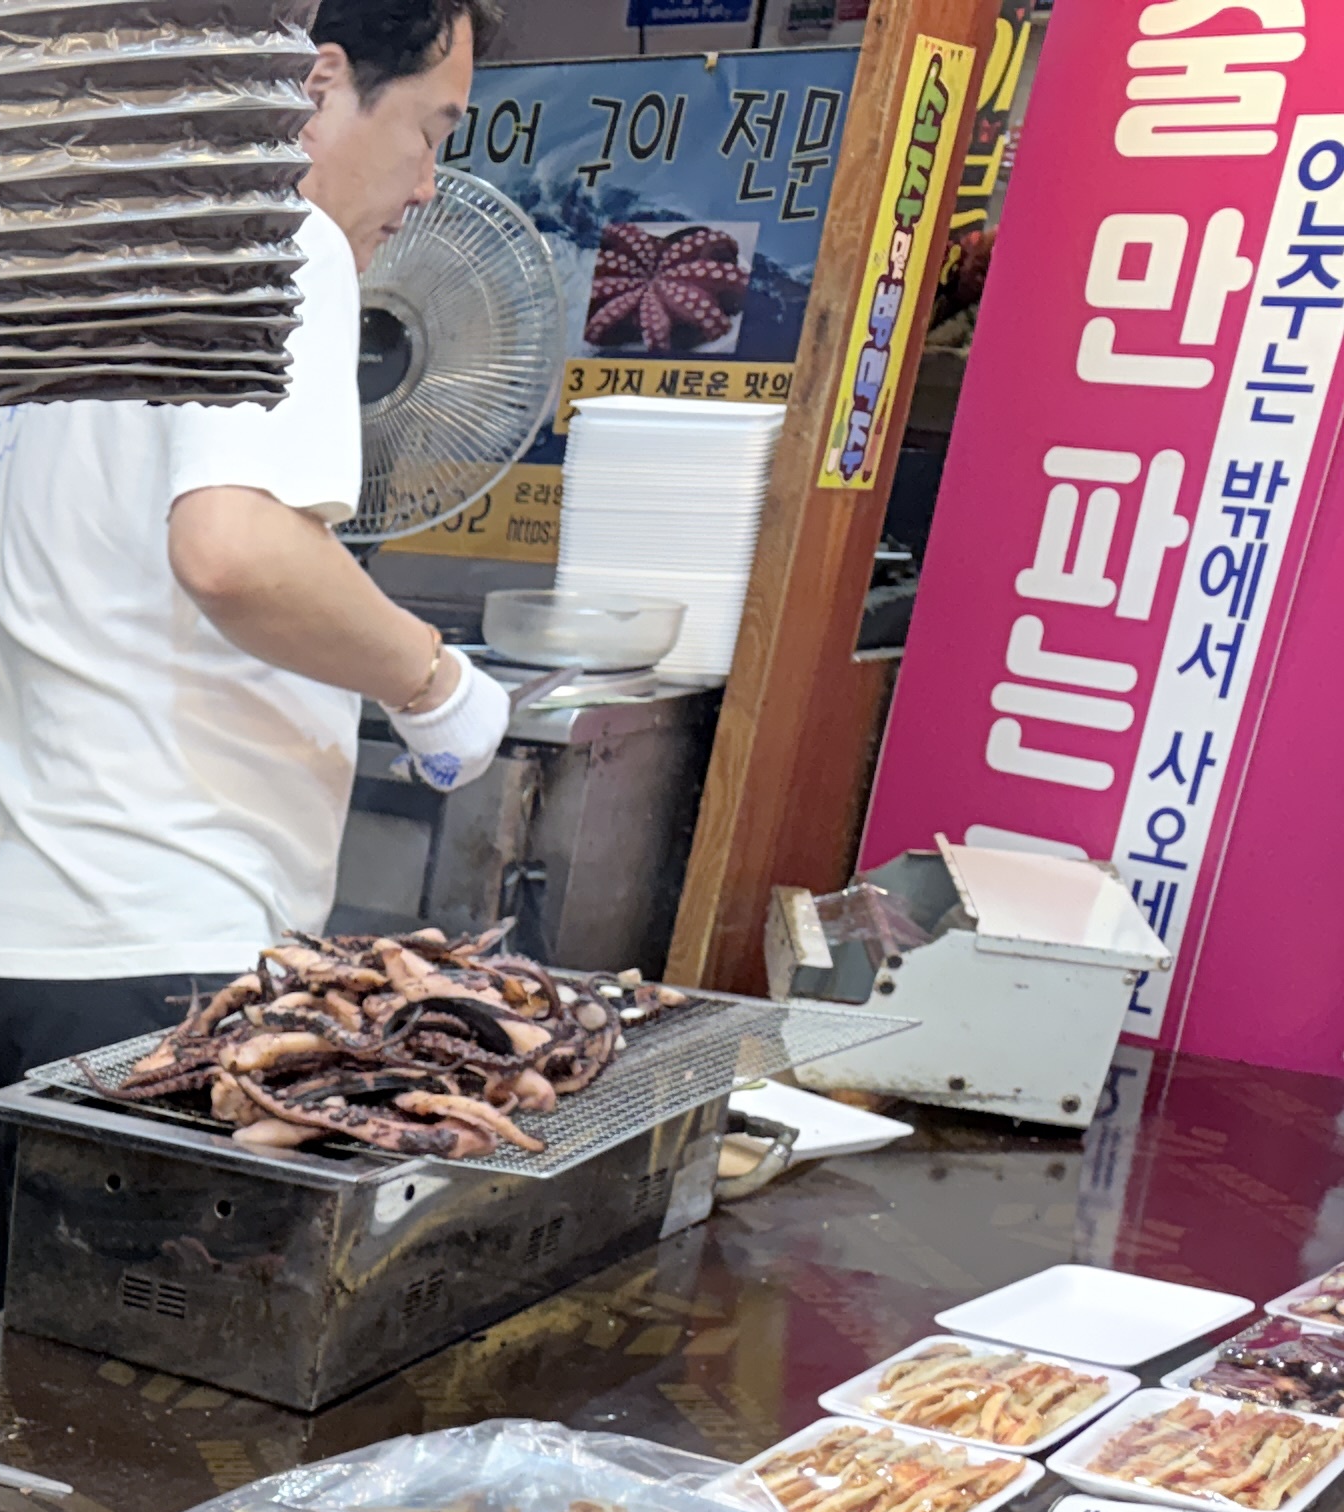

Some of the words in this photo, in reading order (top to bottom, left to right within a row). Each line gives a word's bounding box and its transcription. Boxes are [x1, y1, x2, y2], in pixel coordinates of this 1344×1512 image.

[578, 91, 686, 188] 구이
[719, 87, 844, 223] 전문
[568, 367, 585, 391] 3
[596, 367, 645, 394] 가지
[656, 368, 729, 398] 새로운
[1177, 459, 1290, 700] 밖에서
[1127, 730, 1217, 1015] 사오세
